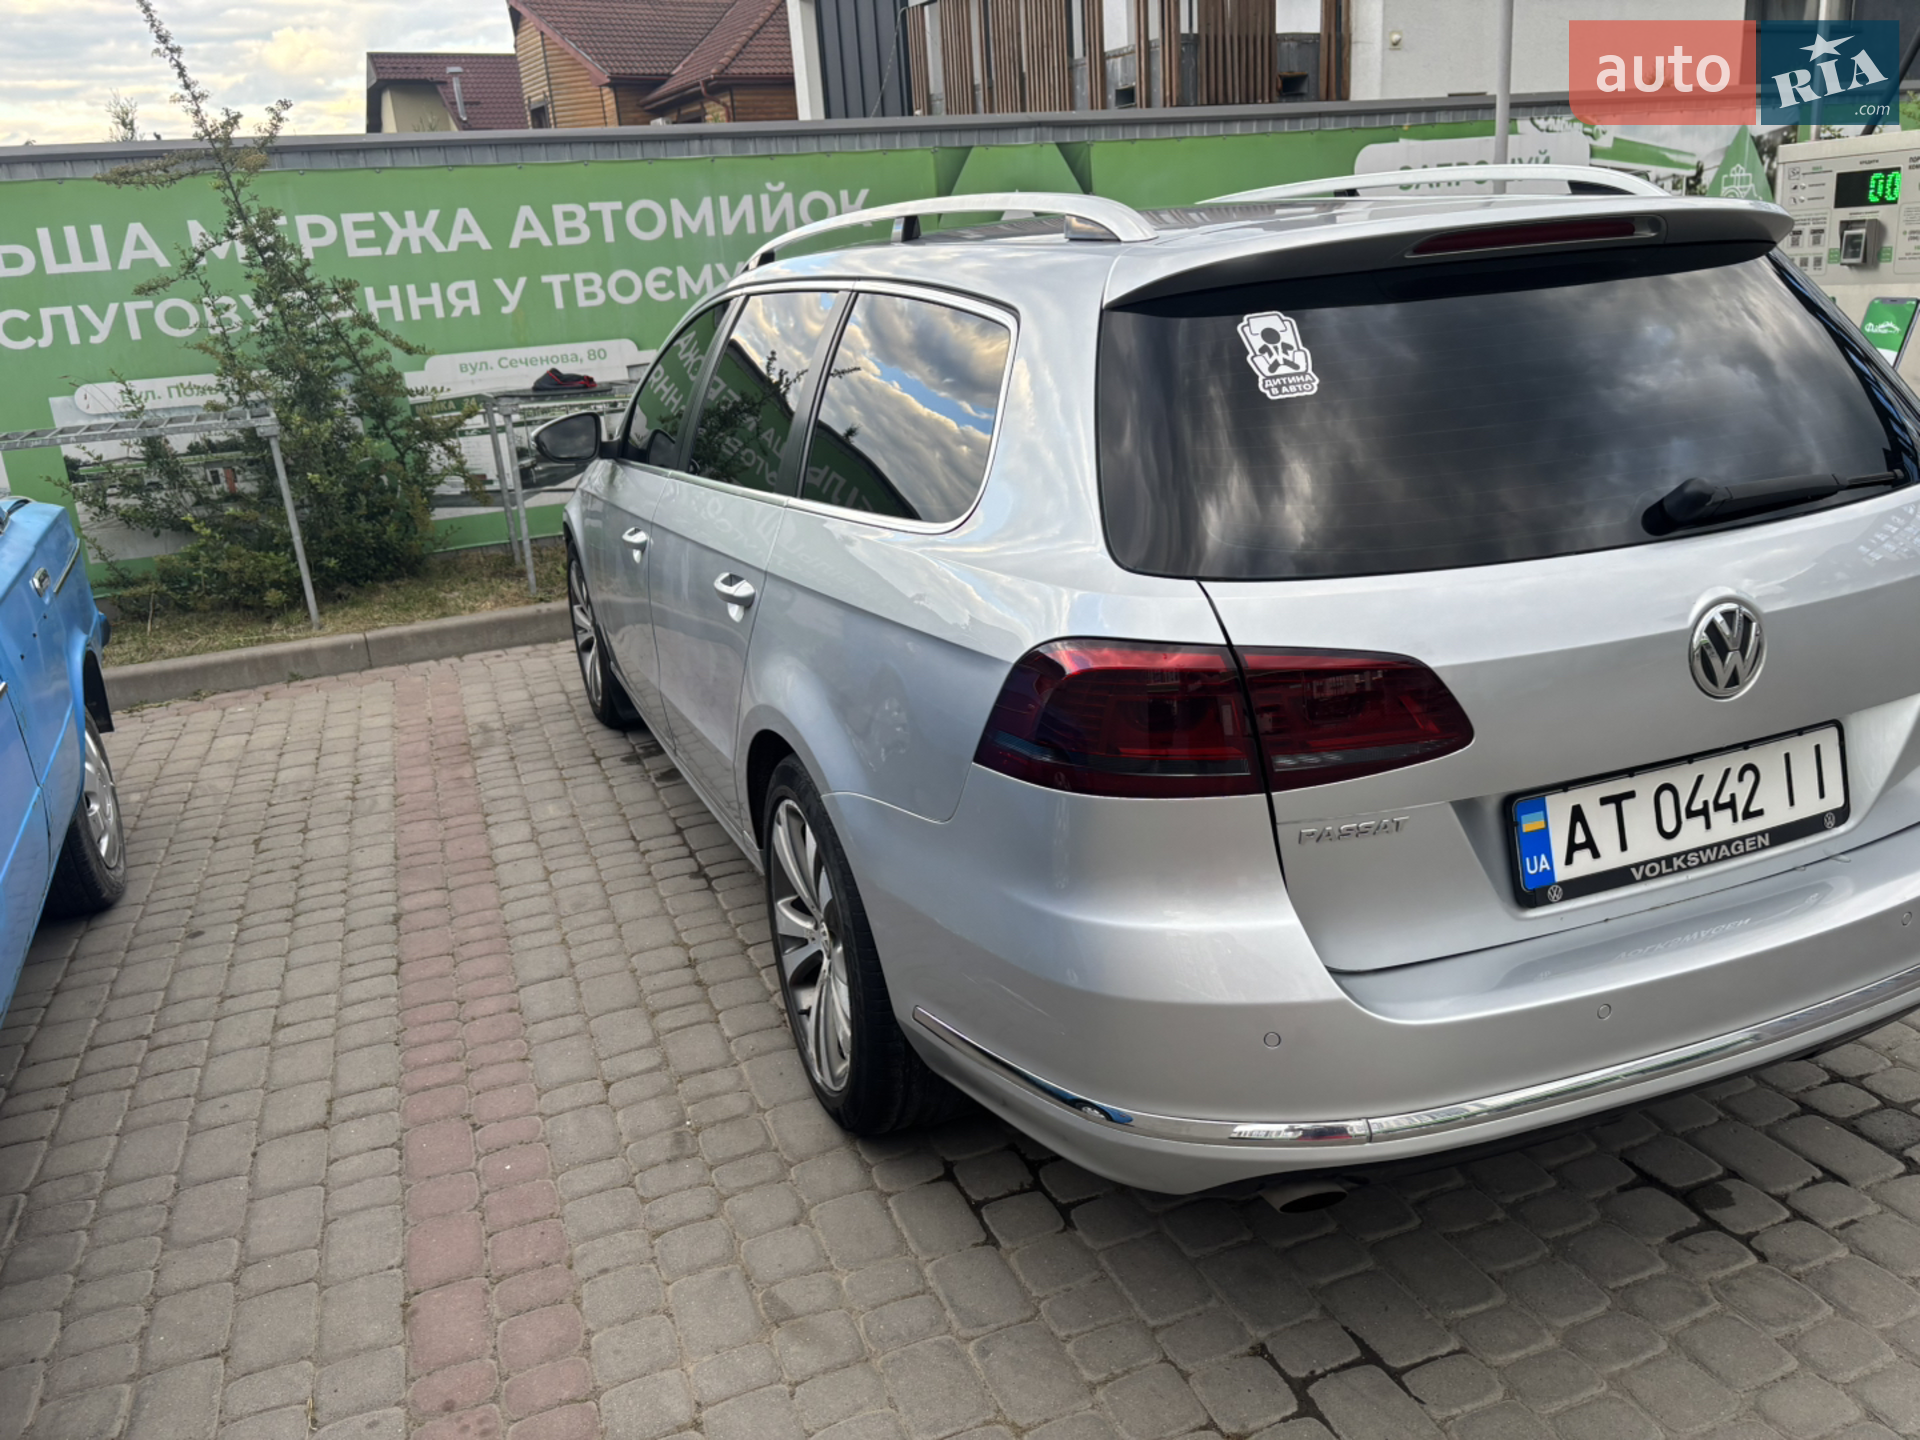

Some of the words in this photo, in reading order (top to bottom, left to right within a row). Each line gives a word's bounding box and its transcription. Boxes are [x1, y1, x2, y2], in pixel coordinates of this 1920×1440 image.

[508, 181, 872, 249] АВТОМИЙОК
[493, 275, 528, 314] У
[459, 361, 494, 376] вул.
[497, 352, 584, 369] Сеченова,
[587, 348, 607, 361] 80
[1264, 374, 1313, 388] ДИТИНА
[1270, 387, 1280, 395] В
[1281, 383, 1312, 394] АВТО
[1564, 790, 1636, 866] AT
[1653, 762, 1765, 840] 0442
[1783, 743, 1826, 808] II
[1298, 815, 1410, 845] PASSAT
[1525, 853, 1551, 875] UA
[1630, 832, 1771, 882] VOLKSWAGEN
